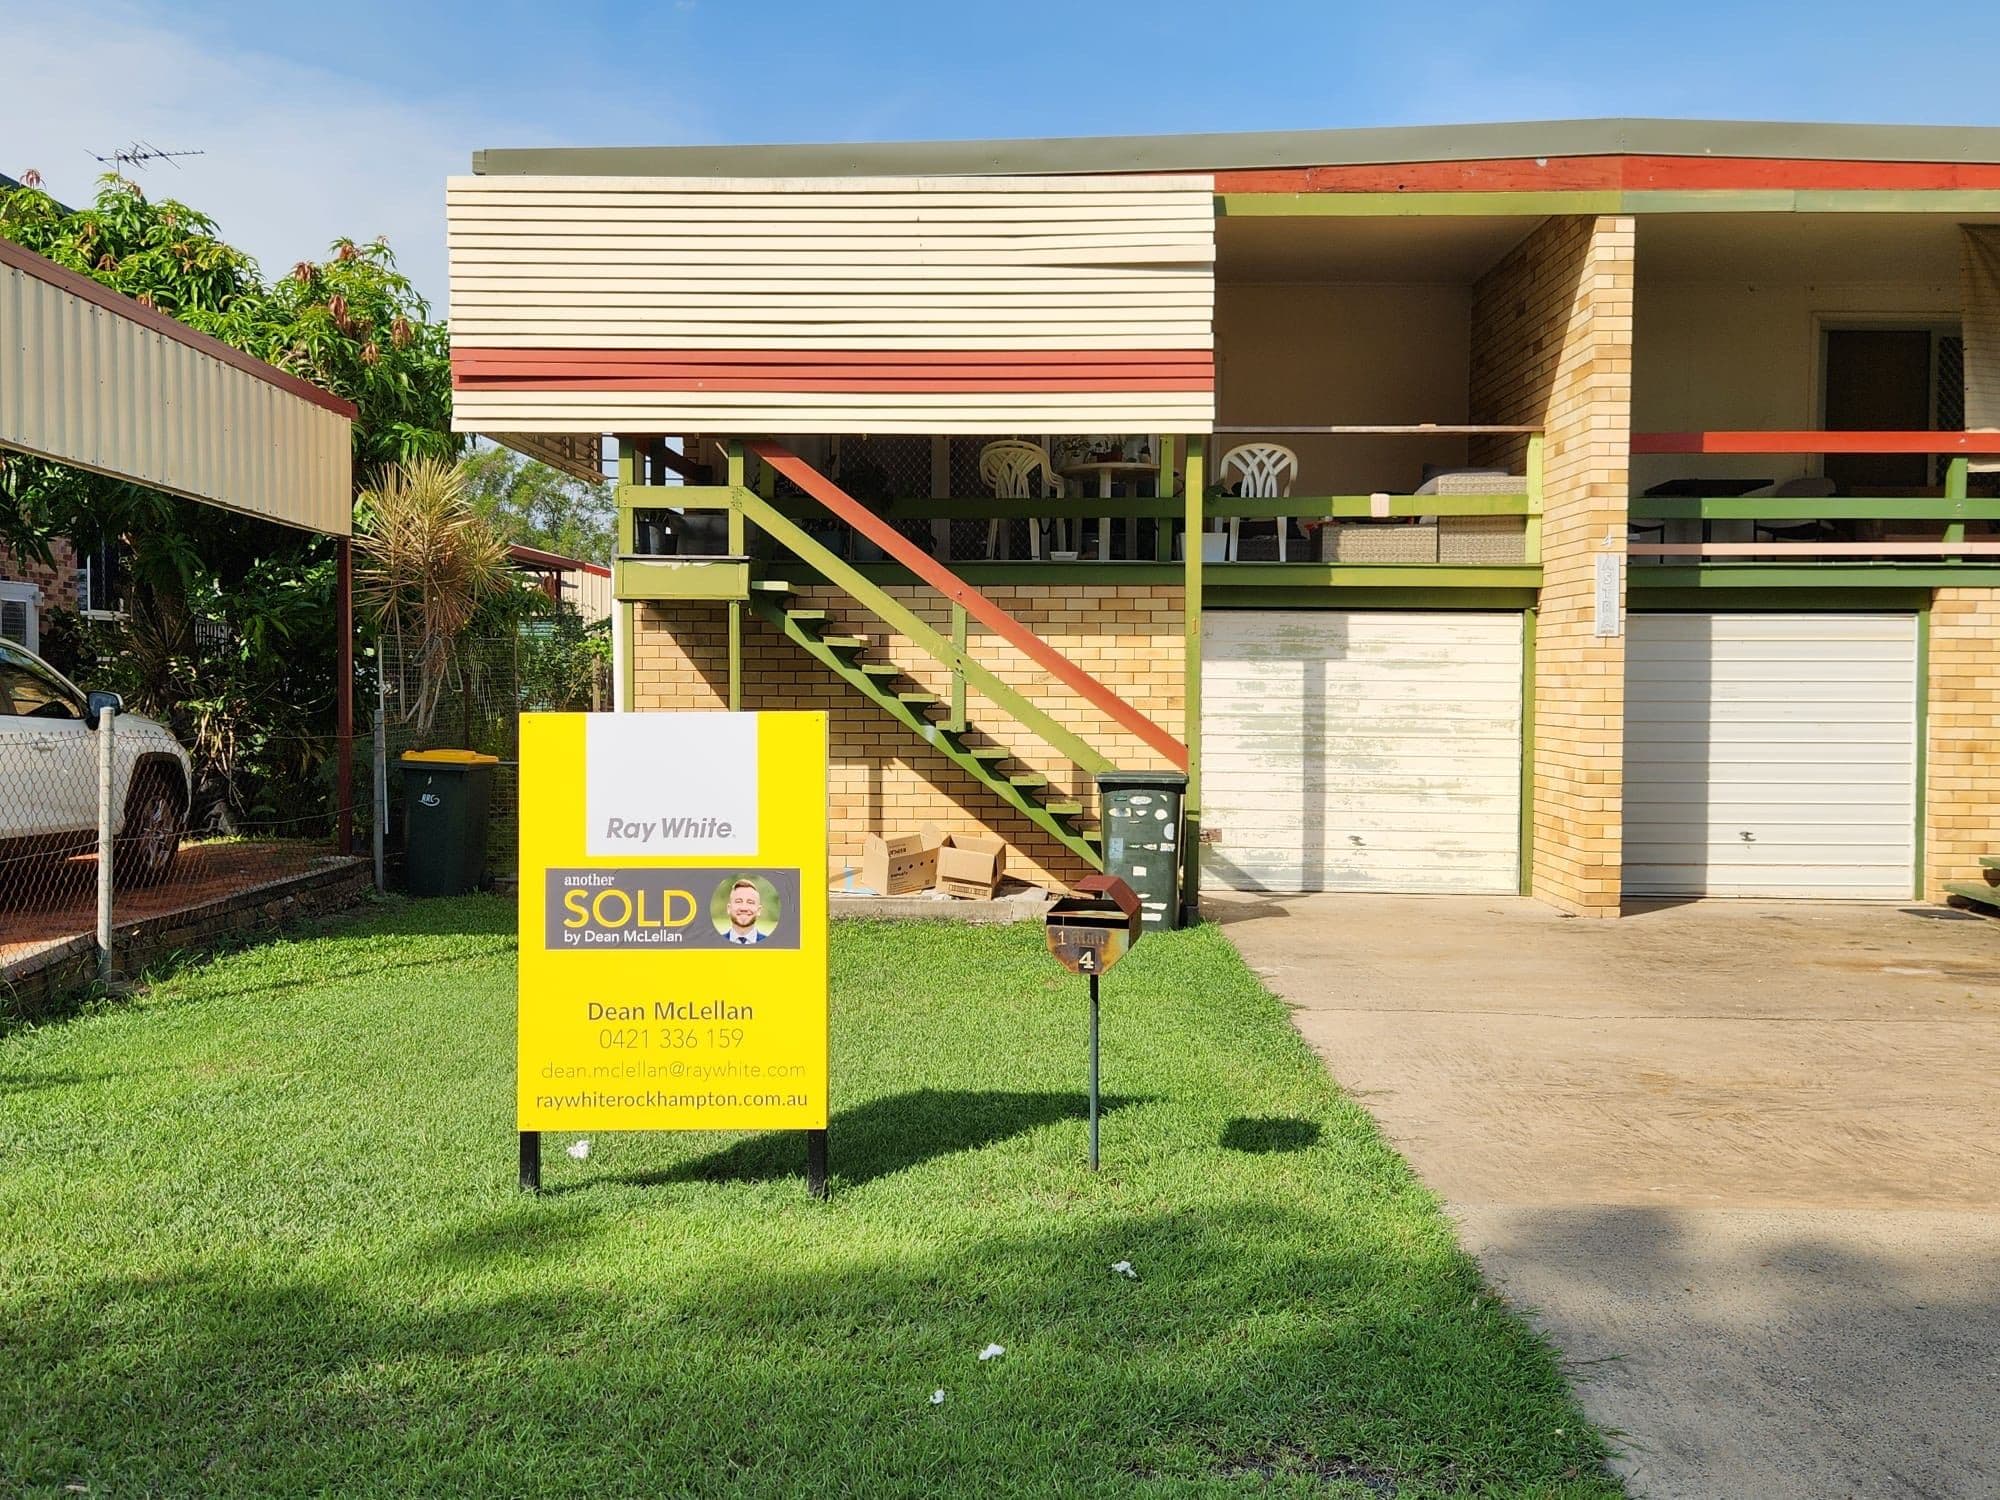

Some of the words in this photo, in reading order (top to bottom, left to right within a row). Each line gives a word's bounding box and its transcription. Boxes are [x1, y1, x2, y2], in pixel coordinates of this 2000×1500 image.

[606, 817, 656, 842] Ray
[662, 817, 733, 839] White
[563, 874, 615, 887] another
[563, 889, 698, 928] SOLD
[563, 930, 580, 944] by
[584, 930, 620, 942] Dean
[623, 930, 683, 943] McLellan
[1078, 950, 1095, 969] 4
[588, 1001, 645, 1021] Dean
[654, 1000, 754, 1020] McLellan
[599, 1028, 650, 1049] 0421
[660, 1028, 698, 1049] 336
[706, 1028, 744, 1049] 159
[541, 1060, 806, 1082] dean.mclellan@raywhite.com
[536, 1089, 808, 1111] raywhiterockhampton.com.au
